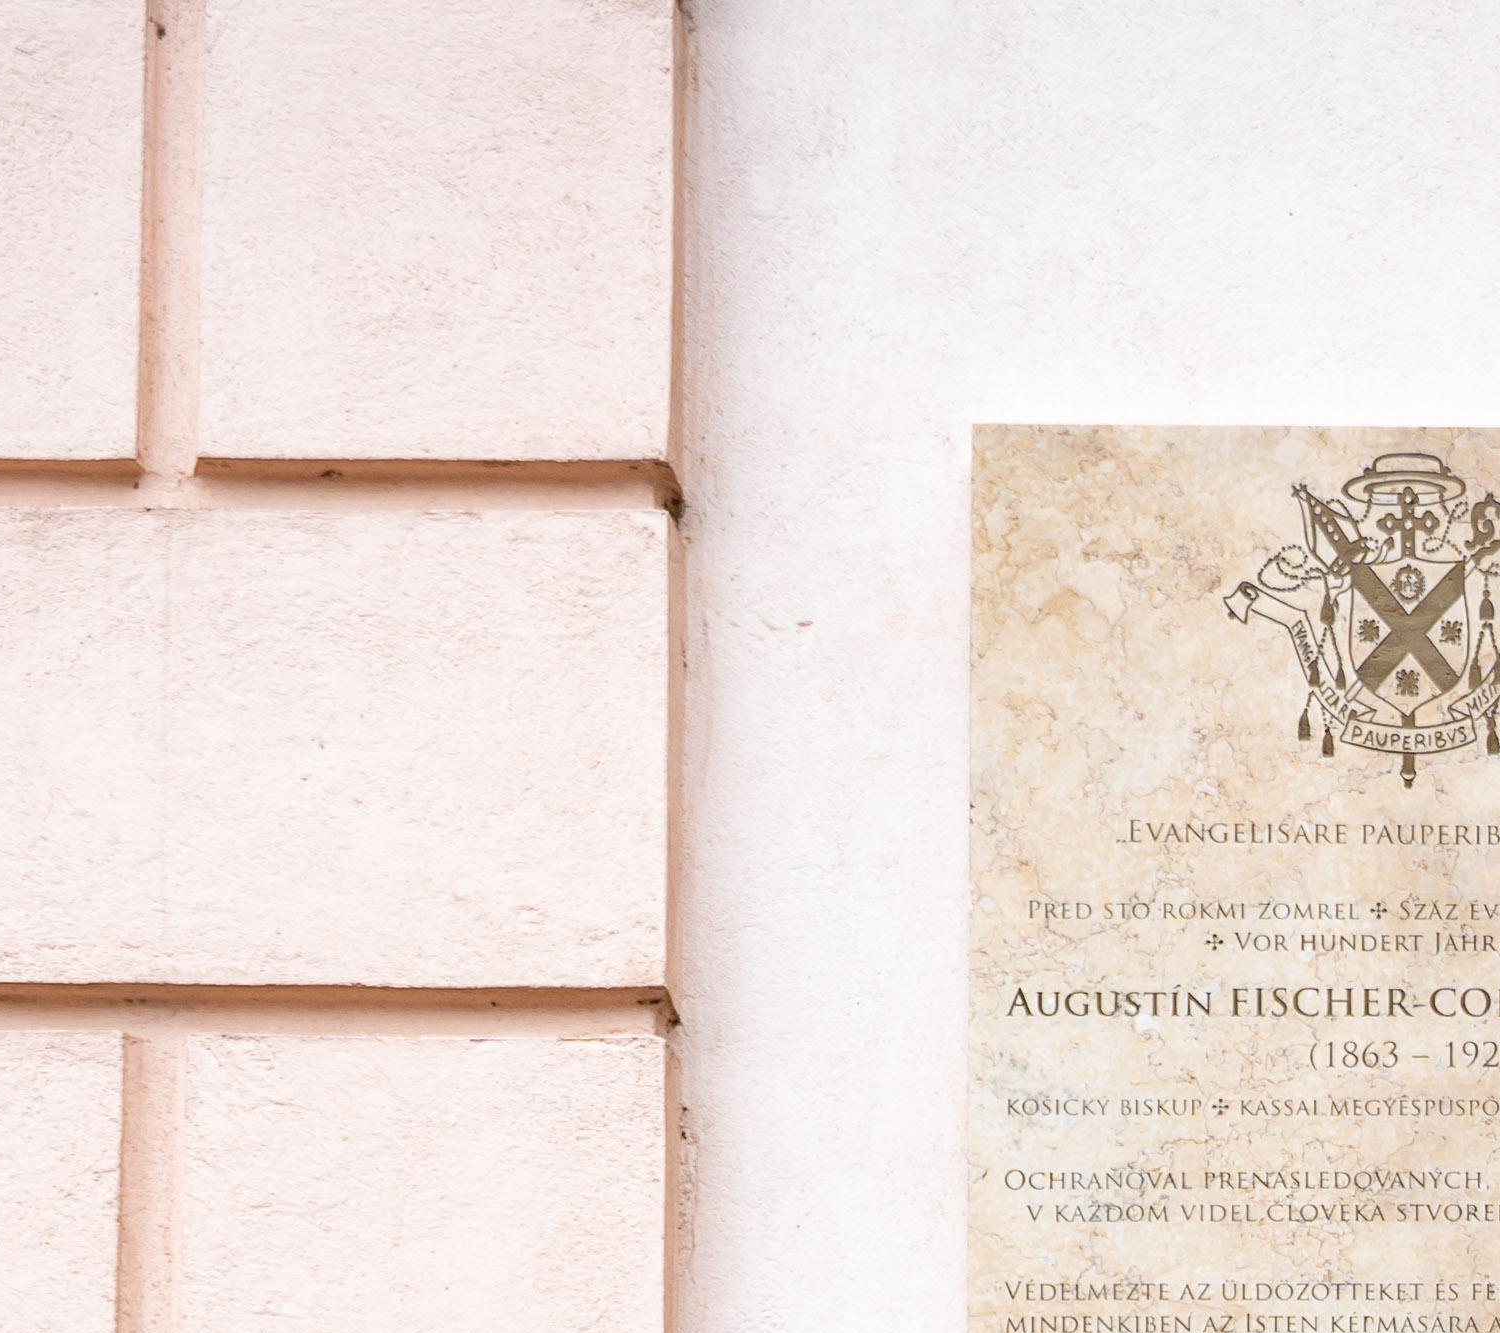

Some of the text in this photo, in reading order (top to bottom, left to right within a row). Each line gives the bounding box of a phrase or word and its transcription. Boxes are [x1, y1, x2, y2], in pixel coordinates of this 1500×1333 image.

[1028, 899, 1092, 921] PRED
[1103, 901, 1151, 921] STO
[1162, 901, 1246, 921] ROKMI
[1258, 902, 1360, 921] ZOMREL
[1233, 932, 1289, 952] VOR
[1299, 933, 1424, 952] HUNDERT
[1006, 984, 1213, 1018] AUGUSTÍN
[1309, 1040, 1399, 1071] (1863
[1119, 1098, 1203, 1117] BISKUP
[1240, 1099, 1319, 1117] KASSAI
[1026, 1204, 1045, 1222] V
[1180, 1204, 1257, 1222] VIDEL
[1266, 1200, 1386, 1223] ČLOVEKA
[1179, 1283, 1212, 1301] AZ
[1435, 1280, 1459, 1301] ÉS
[1005, 1314, 1193, 1333] MINDENKIBEN
[1202, 1315, 1235, 1333] AZ
[1246, 1312, 1318, 1333] ISTEN
[1330, 1311, 1478, 1333] KÉPMÁSÁRA
